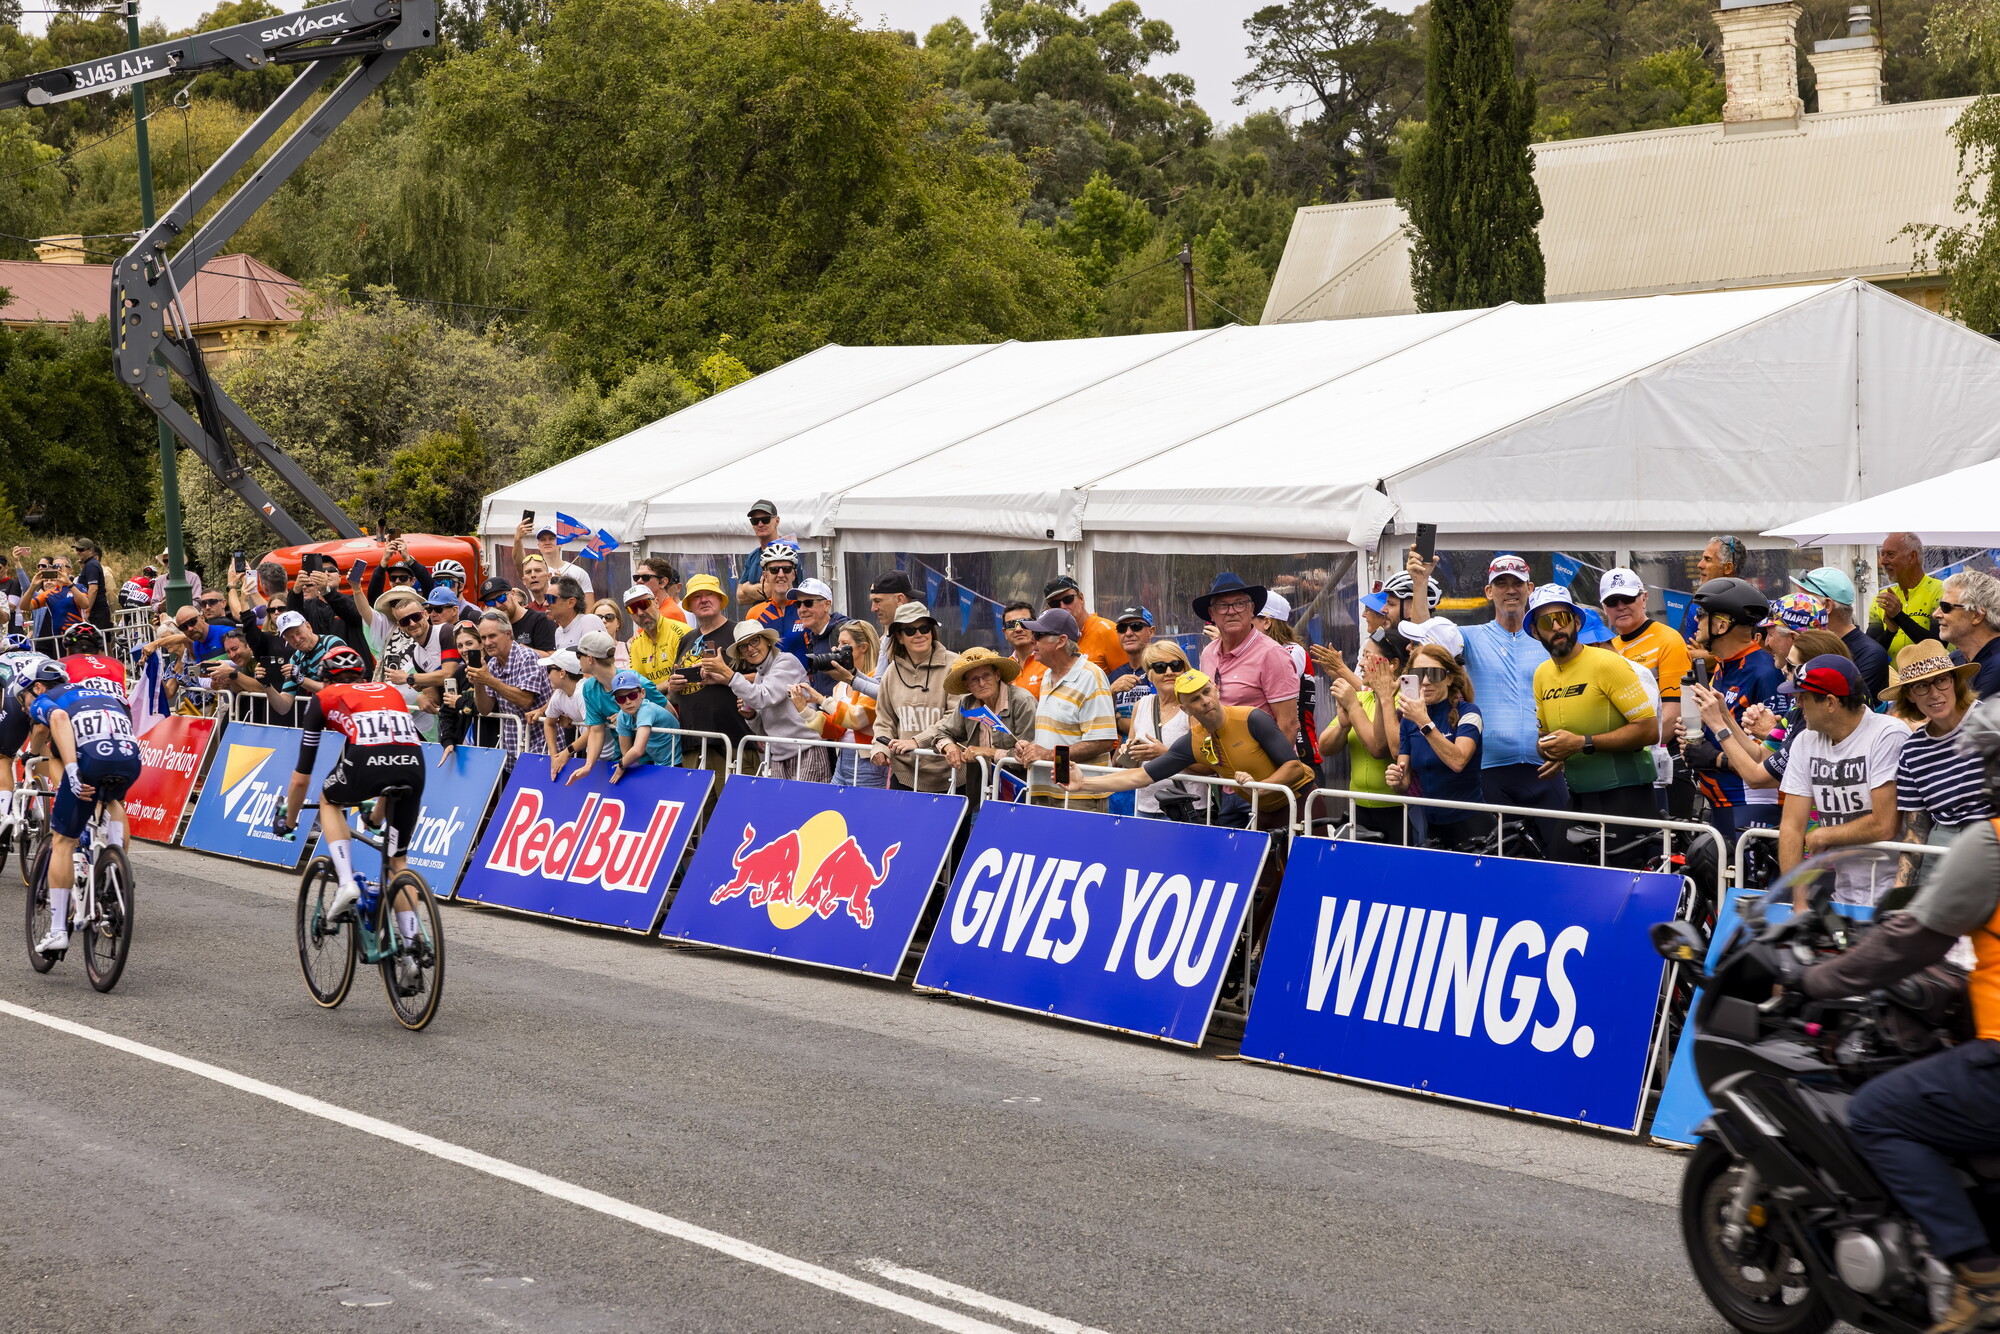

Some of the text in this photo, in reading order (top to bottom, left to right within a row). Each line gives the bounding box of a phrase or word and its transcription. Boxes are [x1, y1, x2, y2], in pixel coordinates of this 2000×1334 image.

[260, 13, 348, 43] SKYJACK
[75, 56, 154, 89] SJ45 AJ+
[1555, 564, 1573, 576] Santos
[1667, 600, 1684, 610] Santos
[1783, 611, 1810, 625] MAPEI
[1542, 687, 1563, 700] LCC
[74, 715, 102, 738] 187
[356, 717, 389, 738] 114
[165, 743, 199, 779] Parking
[366, 755, 419, 766] ARKEA
[1844, 761, 1865, 782] try
[126, 799, 167, 825] with your day
[485, 787, 685, 893] Red Bull
[951, 847, 1239, 988] GIVES YOU
[1306, 896, 1595, 1058] WIIINGS.
